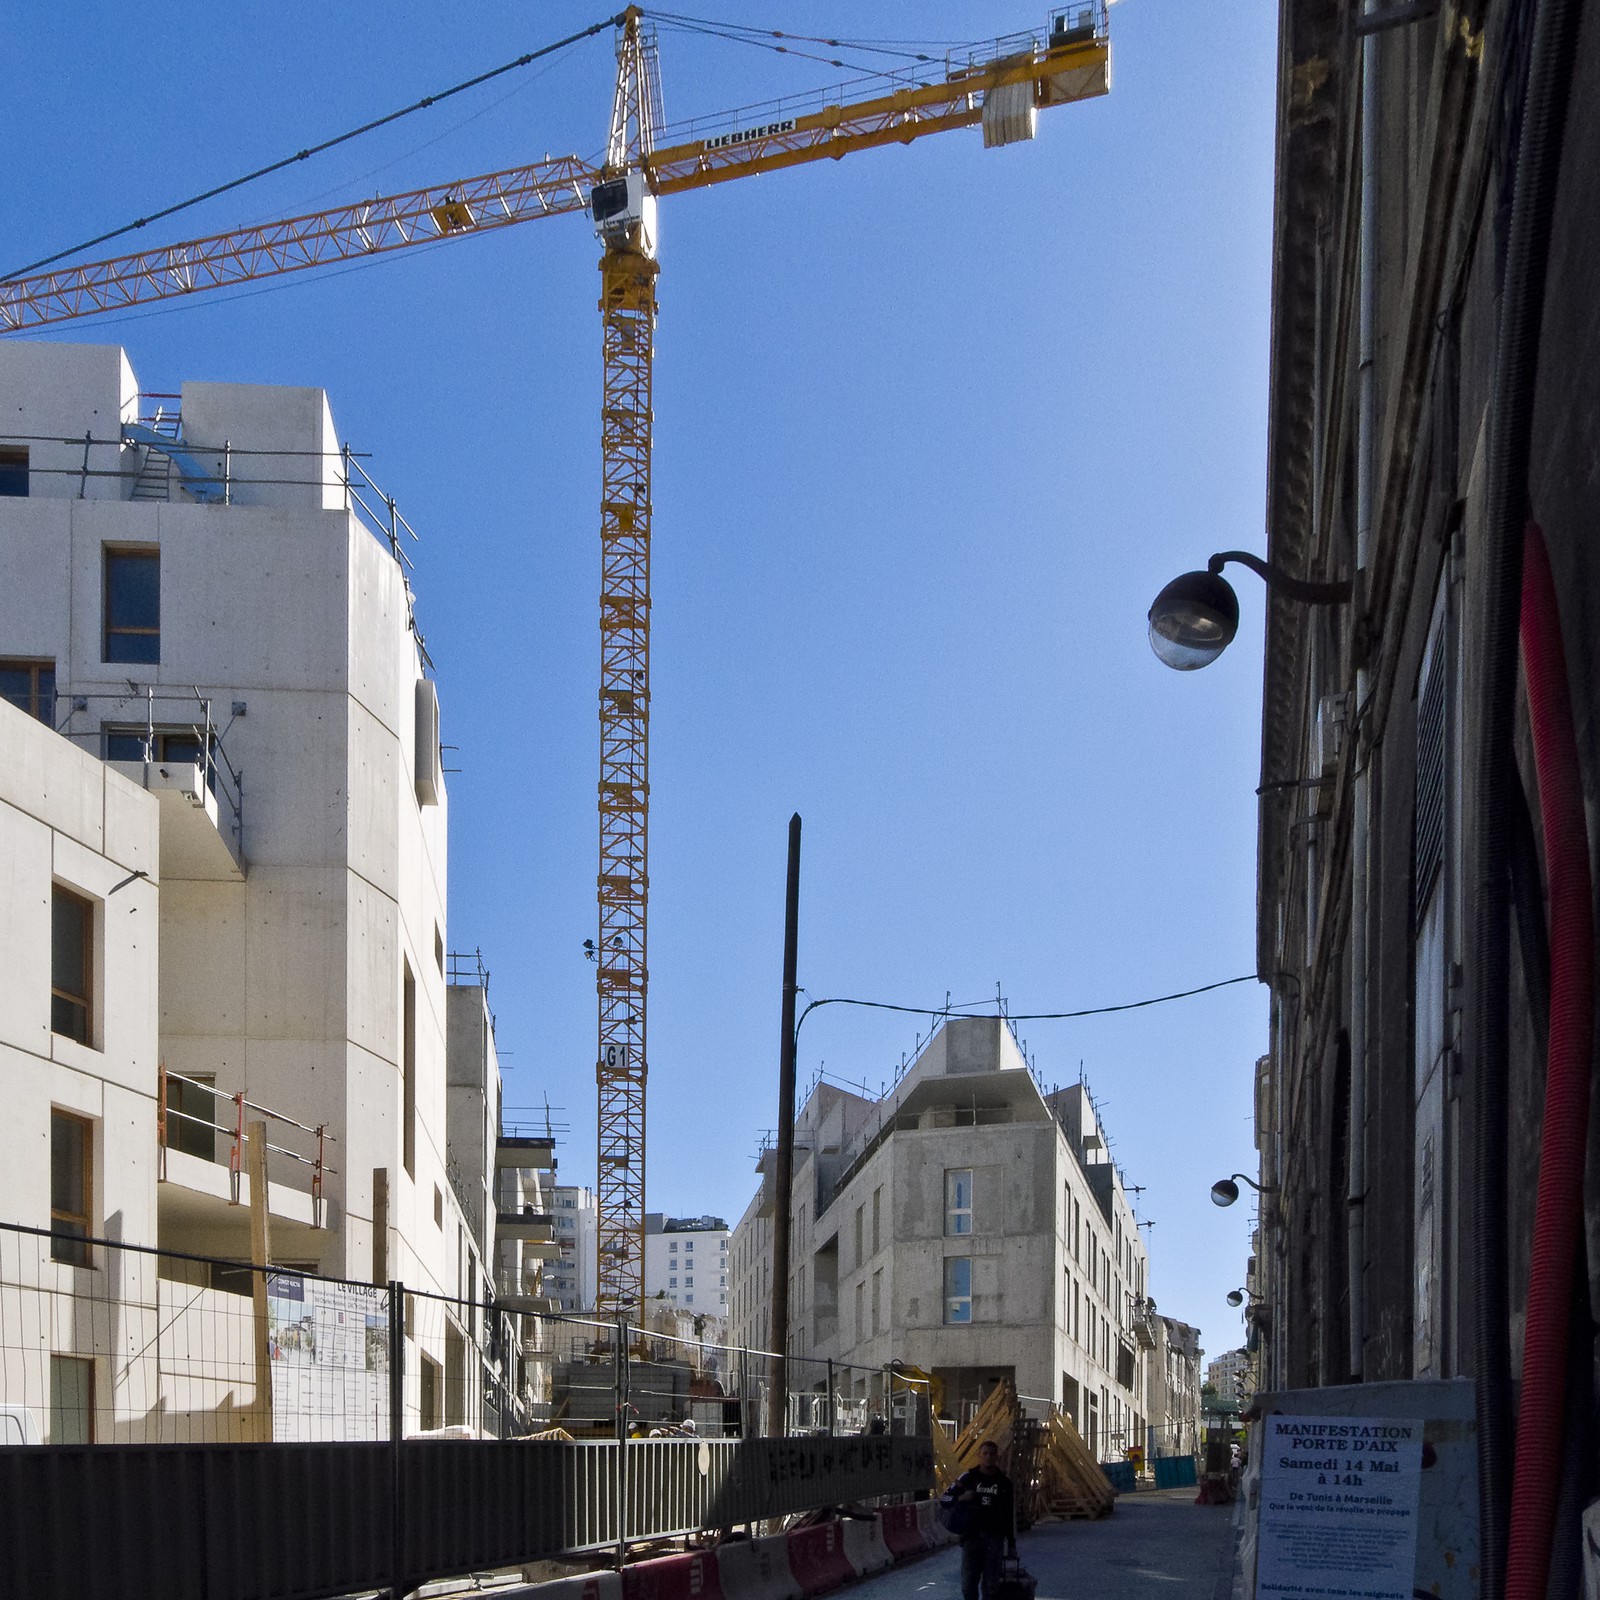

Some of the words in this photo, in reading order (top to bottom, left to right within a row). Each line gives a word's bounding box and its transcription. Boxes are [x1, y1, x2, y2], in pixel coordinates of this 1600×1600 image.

[706, 120, 793, 149] LIEBHERR
[607, 1046, 626, 1067] G1
[338, 1282, 346, 1293] LE
[347, 1283, 377, 1299] VILLAGE
[1275, 1424, 1412, 1438] MANIFESTATION
[1292, 1438, 1348, 1450] PORTE
[1353, 1440, 1398, 1452] D'AIX
[1279, 1457, 1338, 1470] Samedi
[1345, 1460, 1363, 1471] 14
[1370, 1461, 1399, 1472] Mai
[1318, 1473, 1326, 1485] à
[1333, 1474, 1363, 1486] 14h
[1289, 1492, 1304, 1501] De
[1306, 1493, 1332, 1502] Tunis
[1335, 1493, 1341, 1502] à
[1344, 1494, 1393, 1505] Marseille
[1269, 1502, 1285, 1511] Que
[1286, 1503, 1294, 1511] le
[1296, 1504, 1313, 1512] vent
[1315, 1504, 1325, 1512] de
[1336, 1505, 1364, 1514] révolte
[1376, 1508, 1410, 1518] propage
[1261, 1583, 1303, 1593] Solidarité
[1327, 1587, 1347, 1596] tous
[1349, 1589, 1362, 1597] les
[1364, 1590, 1404, 1600] migrants
